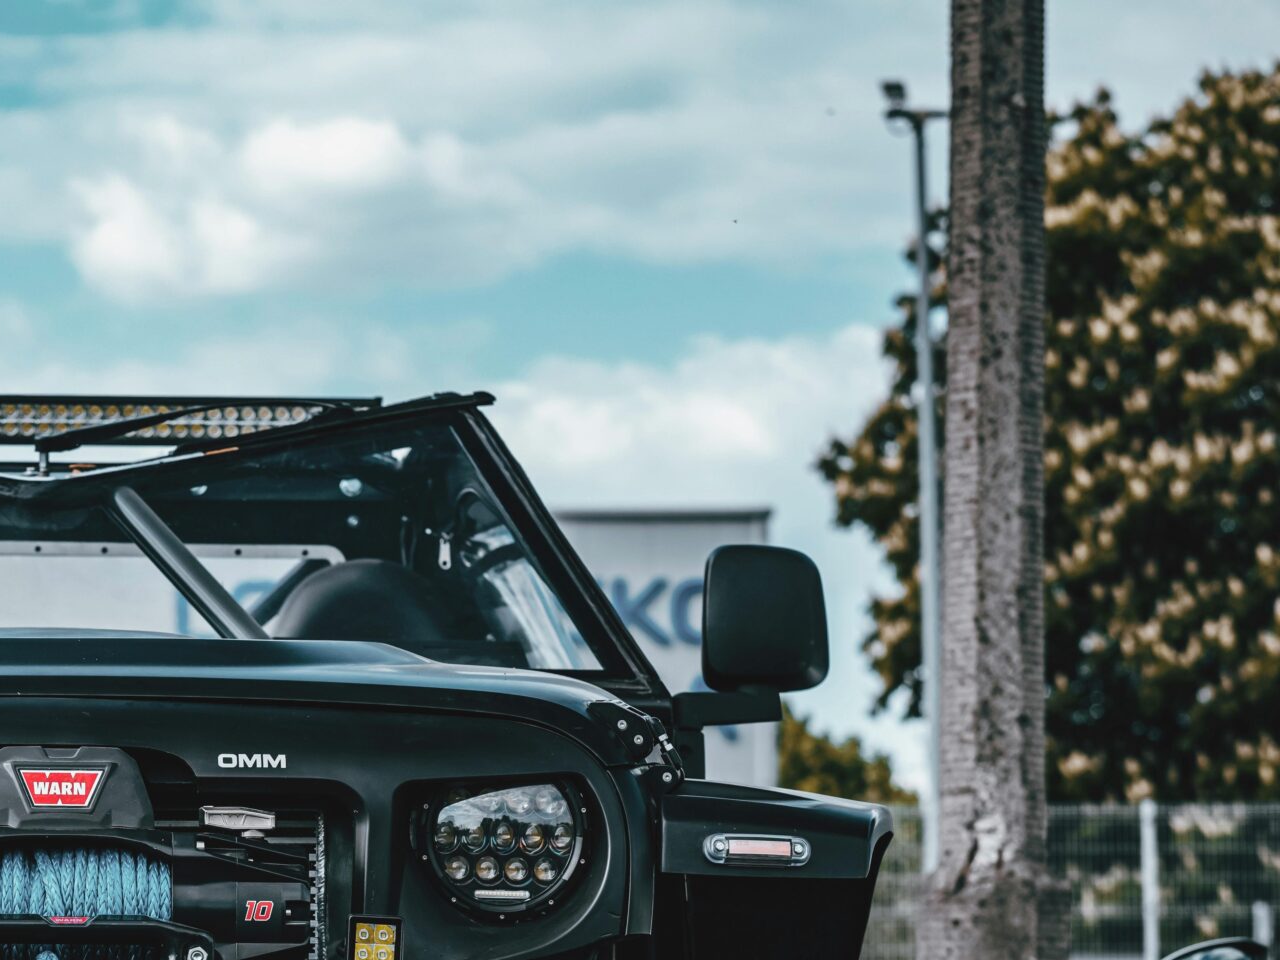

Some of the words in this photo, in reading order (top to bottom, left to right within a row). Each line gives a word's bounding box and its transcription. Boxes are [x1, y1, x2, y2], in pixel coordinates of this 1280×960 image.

[217, 753, 287, 768] OMM
[33, 781, 86, 795] WARN
[245, 900, 274, 921] 10
